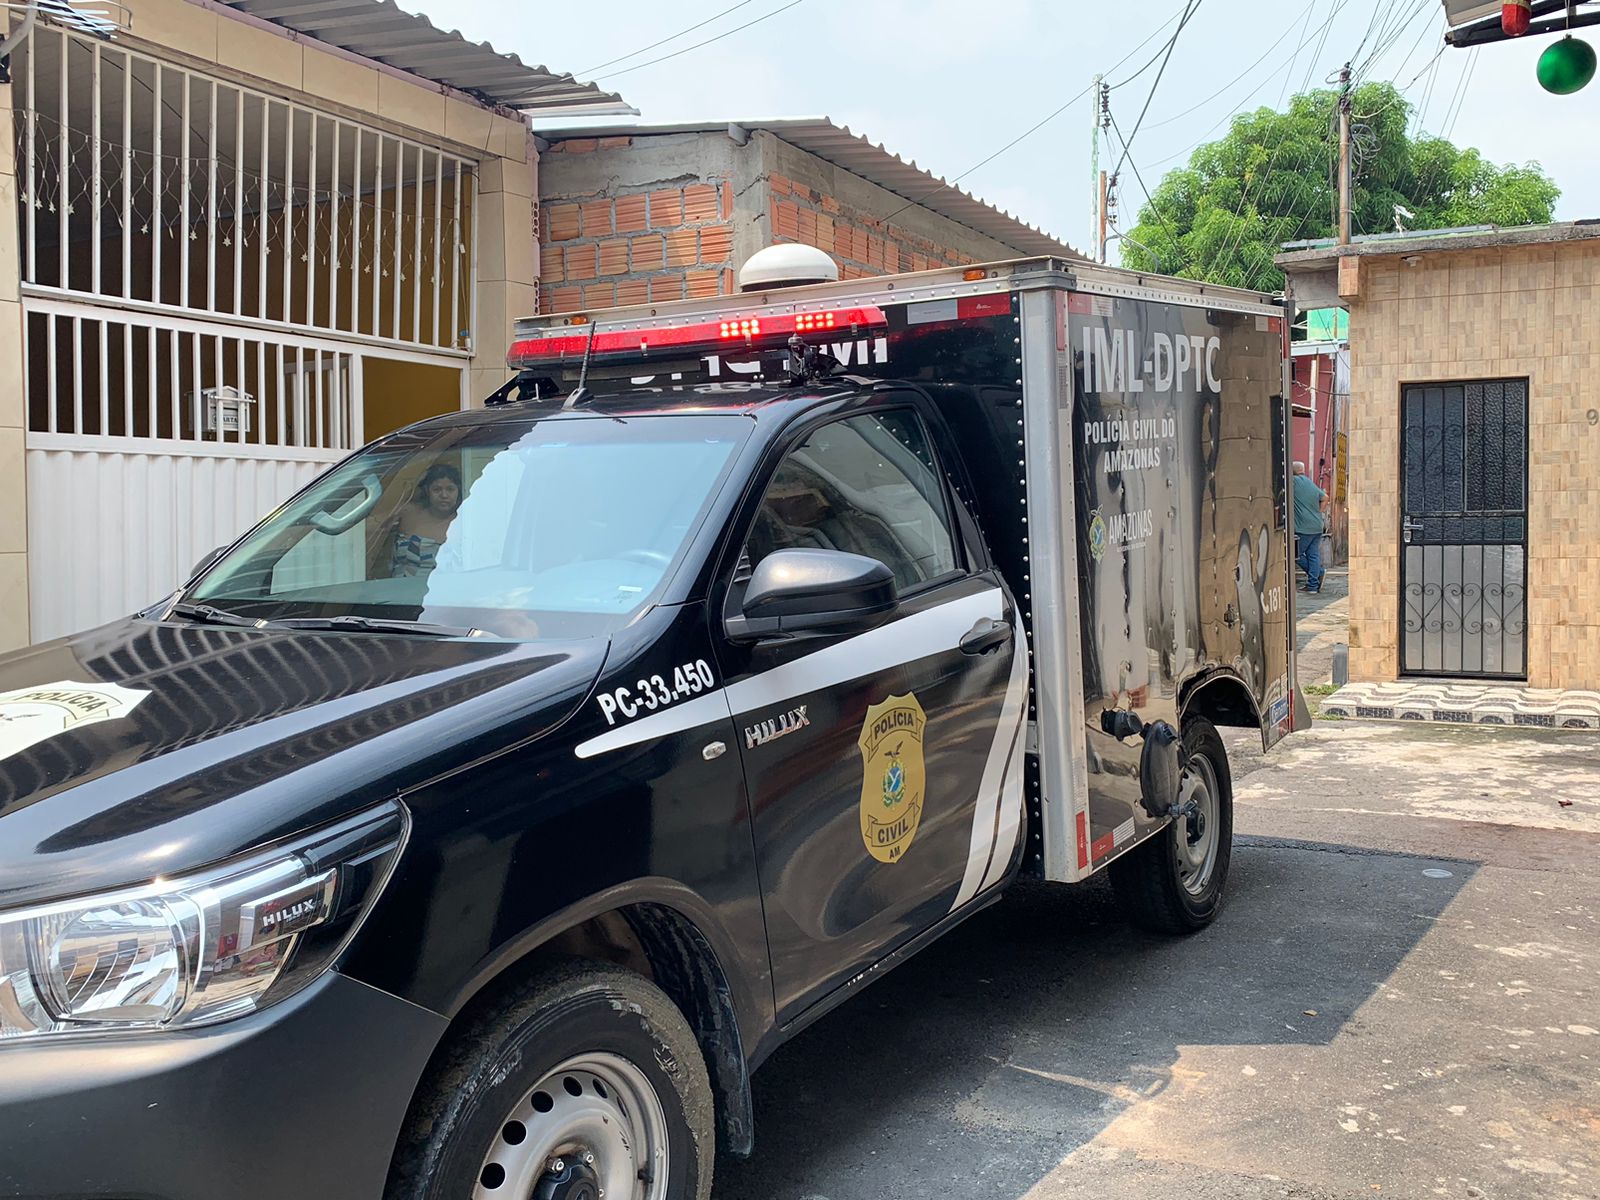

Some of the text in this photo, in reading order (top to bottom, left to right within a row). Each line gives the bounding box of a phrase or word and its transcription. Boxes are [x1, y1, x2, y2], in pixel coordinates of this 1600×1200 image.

[1082, 326, 1222, 394] IML-DPTC
[1084, 414, 1175, 445] POLÍCIA CIVIL DO
[1103, 447, 1160, 473] AMAZONAS
[1108, 509, 1153, 545] AMAZONAS
[1269, 586, 1281, 613] 181
[23, 691, 107, 712] POLÍCIA
[596, 659, 714, 726] PC-33.450
[744, 705, 810, 749] HILUX
[874, 710, 915, 740] POLÍCIA
[877, 818, 909, 844] CIVIL
[889, 846, 901, 860] AM
[262, 898, 314, 927] HILUX
